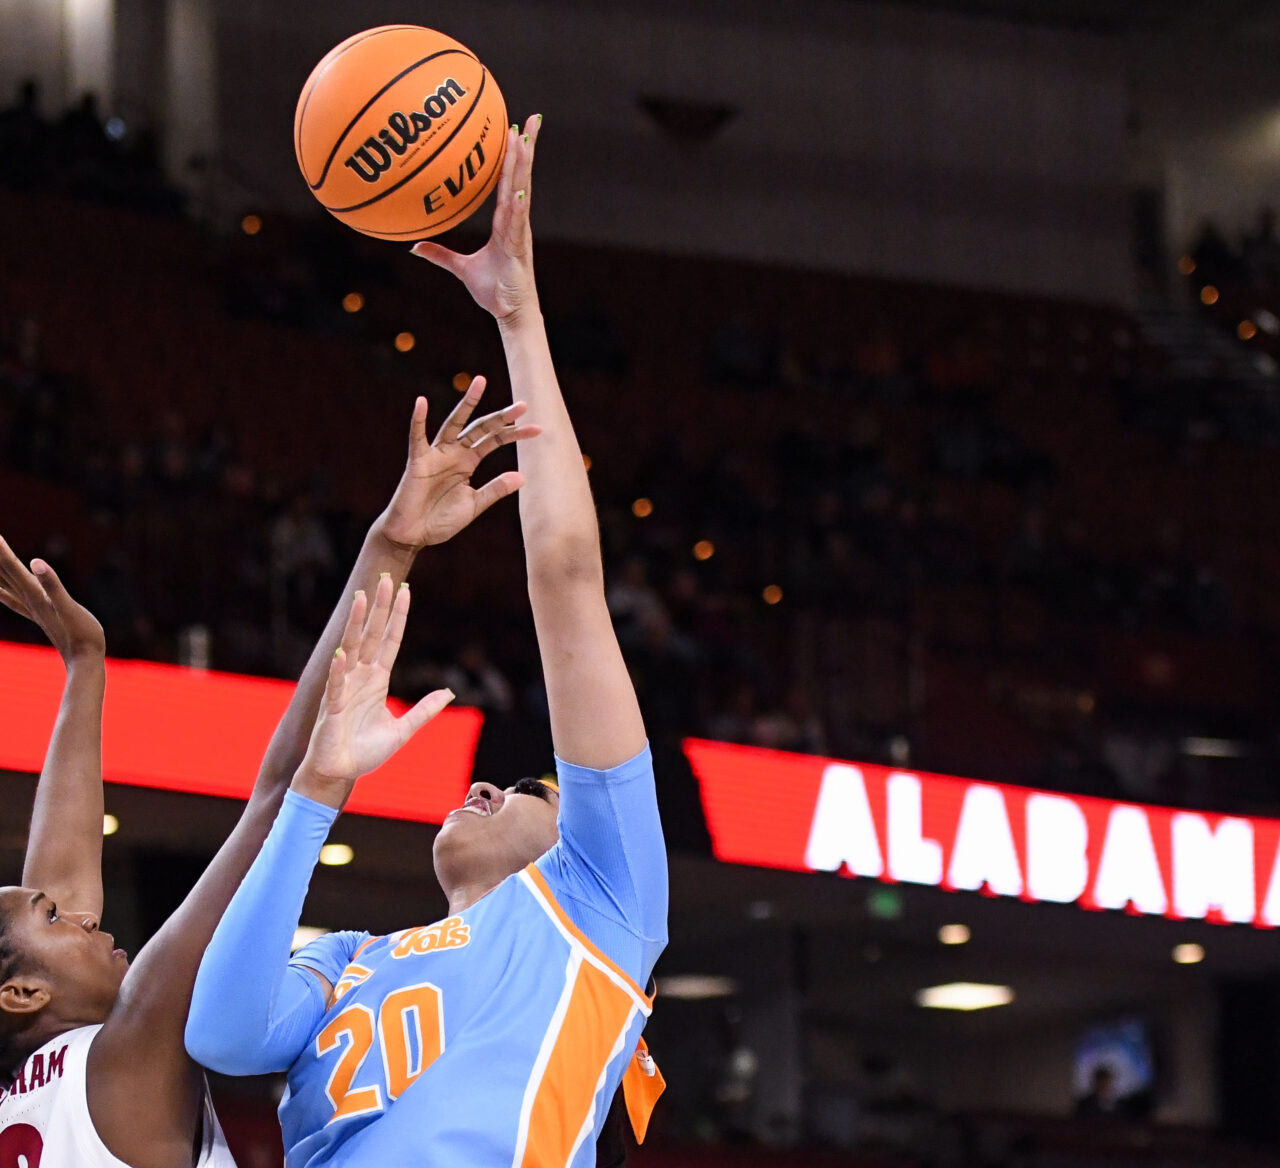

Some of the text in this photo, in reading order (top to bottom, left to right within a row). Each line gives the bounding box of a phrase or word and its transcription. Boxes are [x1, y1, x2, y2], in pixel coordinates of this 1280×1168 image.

[344, 78, 467, 183] Wilson
[424, 141, 485, 215] EVO
[803, 762, 1280, 927] ALABAM
[316, 982, 445, 1130] 20
